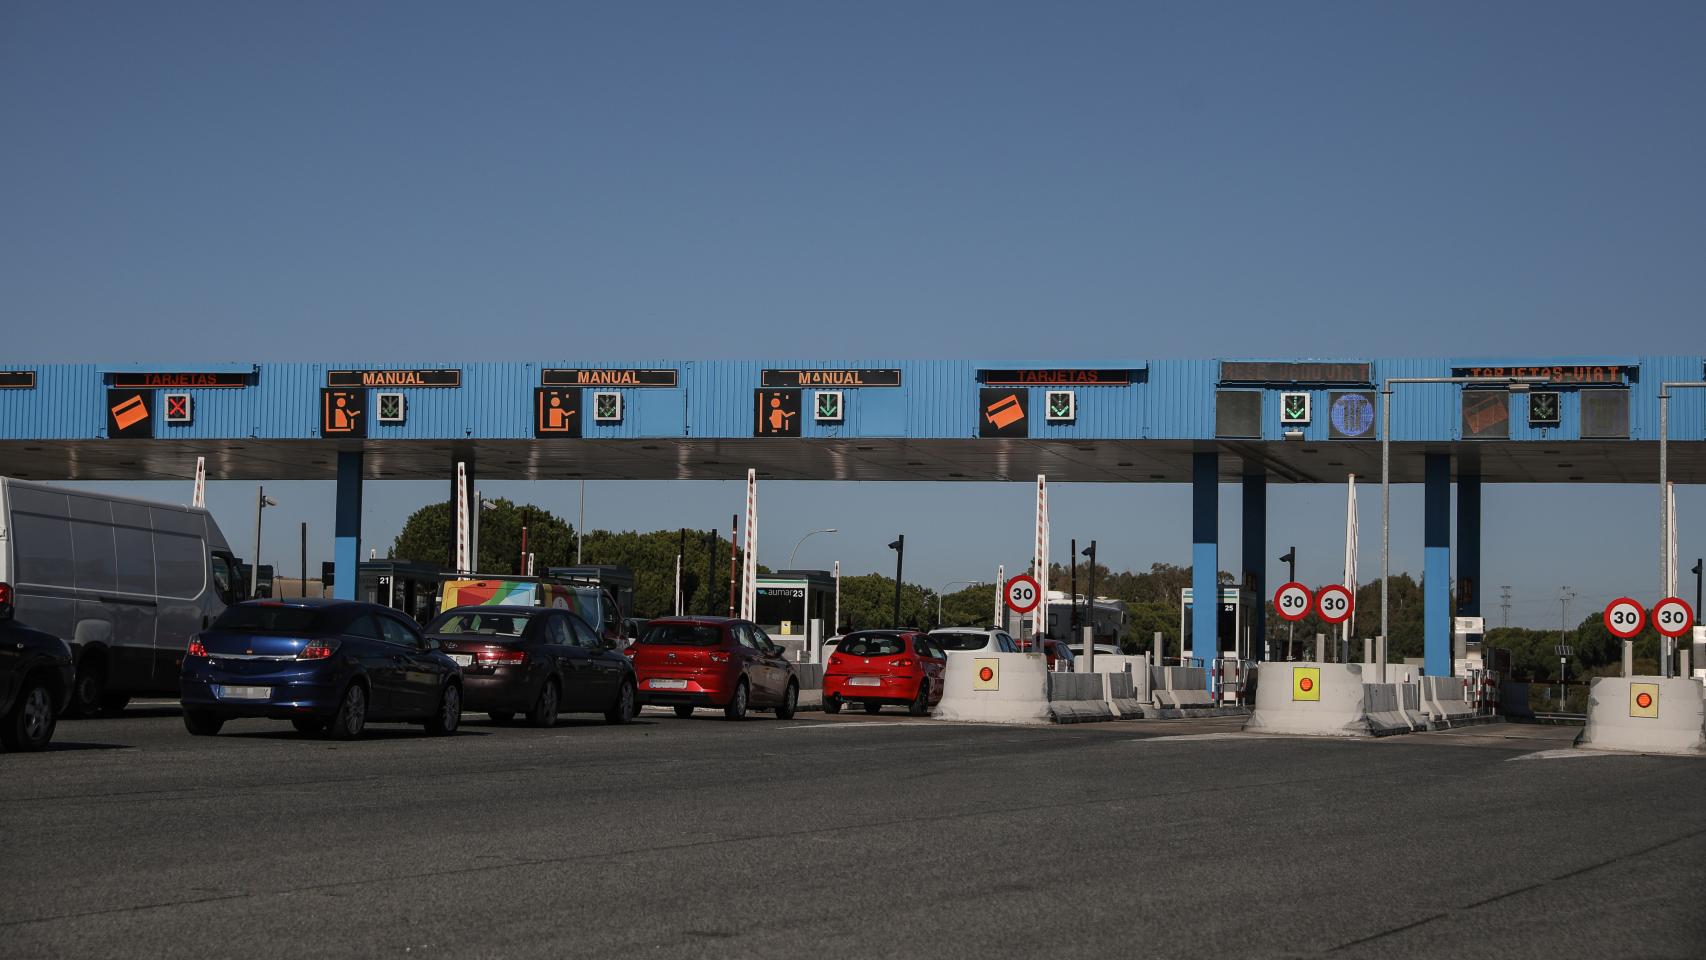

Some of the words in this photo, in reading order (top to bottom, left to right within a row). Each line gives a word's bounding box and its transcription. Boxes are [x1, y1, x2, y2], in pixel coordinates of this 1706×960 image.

[143, 373, 218, 385] TARJETAS
[363, 372, 425, 384] MANUAL
[577, 371, 641, 384] MANUAL
[798, 372, 863, 384] MANUAL
[1017, 370, 1099, 383] TARJETAS
[1013, 588, 1033, 600] 30
[1282, 595, 1304, 608] 30
[1324, 598, 1346, 610] 30
[1614, 611, 1637, 624] 30
[1661, 611, 1684, 623] 30
